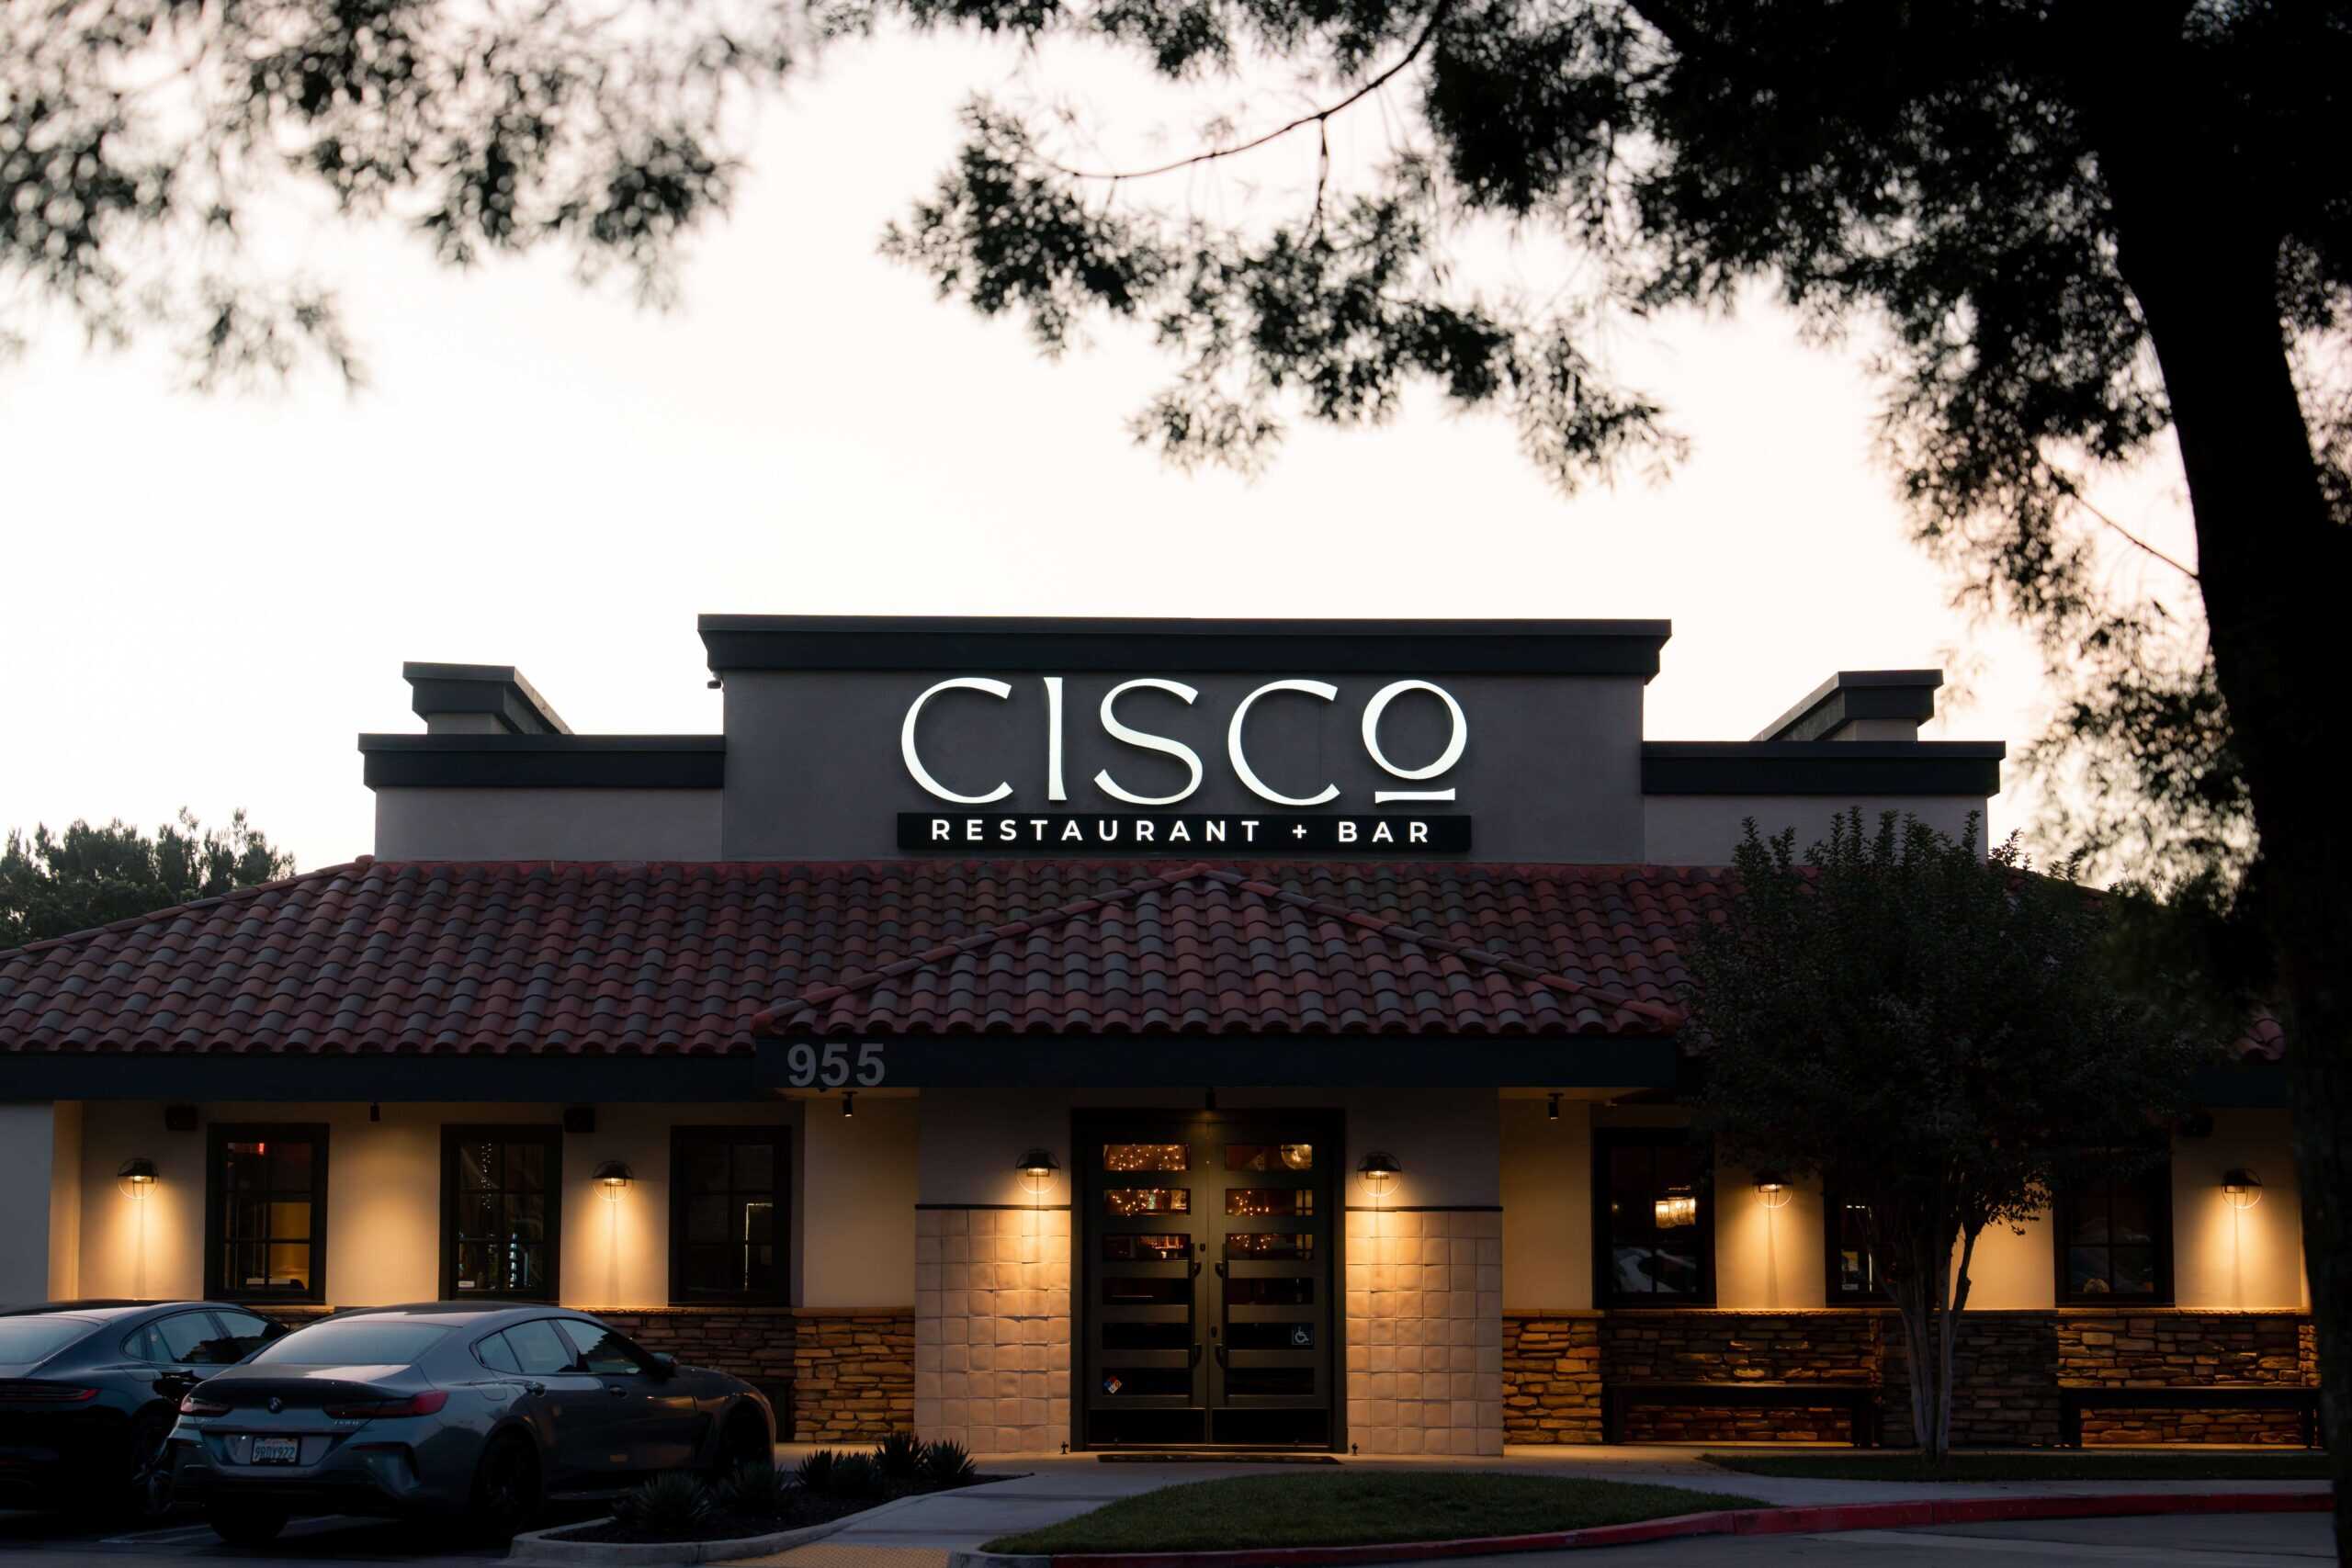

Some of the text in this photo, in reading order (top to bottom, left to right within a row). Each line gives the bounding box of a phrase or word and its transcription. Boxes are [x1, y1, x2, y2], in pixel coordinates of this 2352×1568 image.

[900, 676, 1468, 806] CISCO
[931, 818, 1261, 842] RESTAURANT
[1338, 820, 1430, 843] BAR
[787, 1043, 886, 1088] 955
